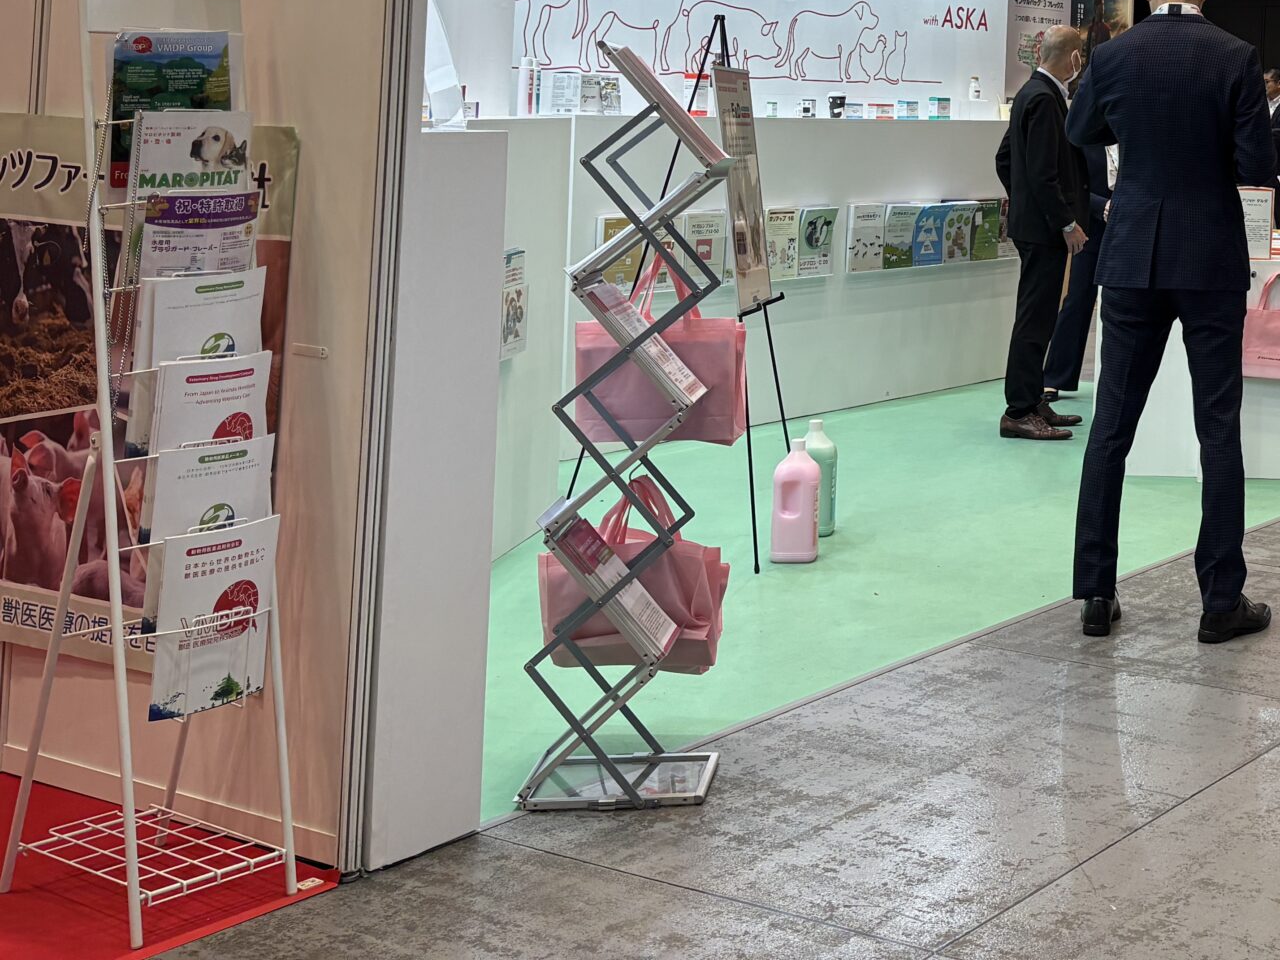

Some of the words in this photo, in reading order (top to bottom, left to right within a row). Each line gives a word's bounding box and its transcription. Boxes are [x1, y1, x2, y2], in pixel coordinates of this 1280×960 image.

[922, 16, 939, 26] with
[941, 5, 989, 32] ASKA
[158, 43, 186, 52] VMDP
[187, 43, 213, 53] Group
[138, 170, 241, 189] MAROPITAT
[175, 198, 245, 214] 祝・特許取得
[1, 597, 156, 654] 獣医医療の提を
